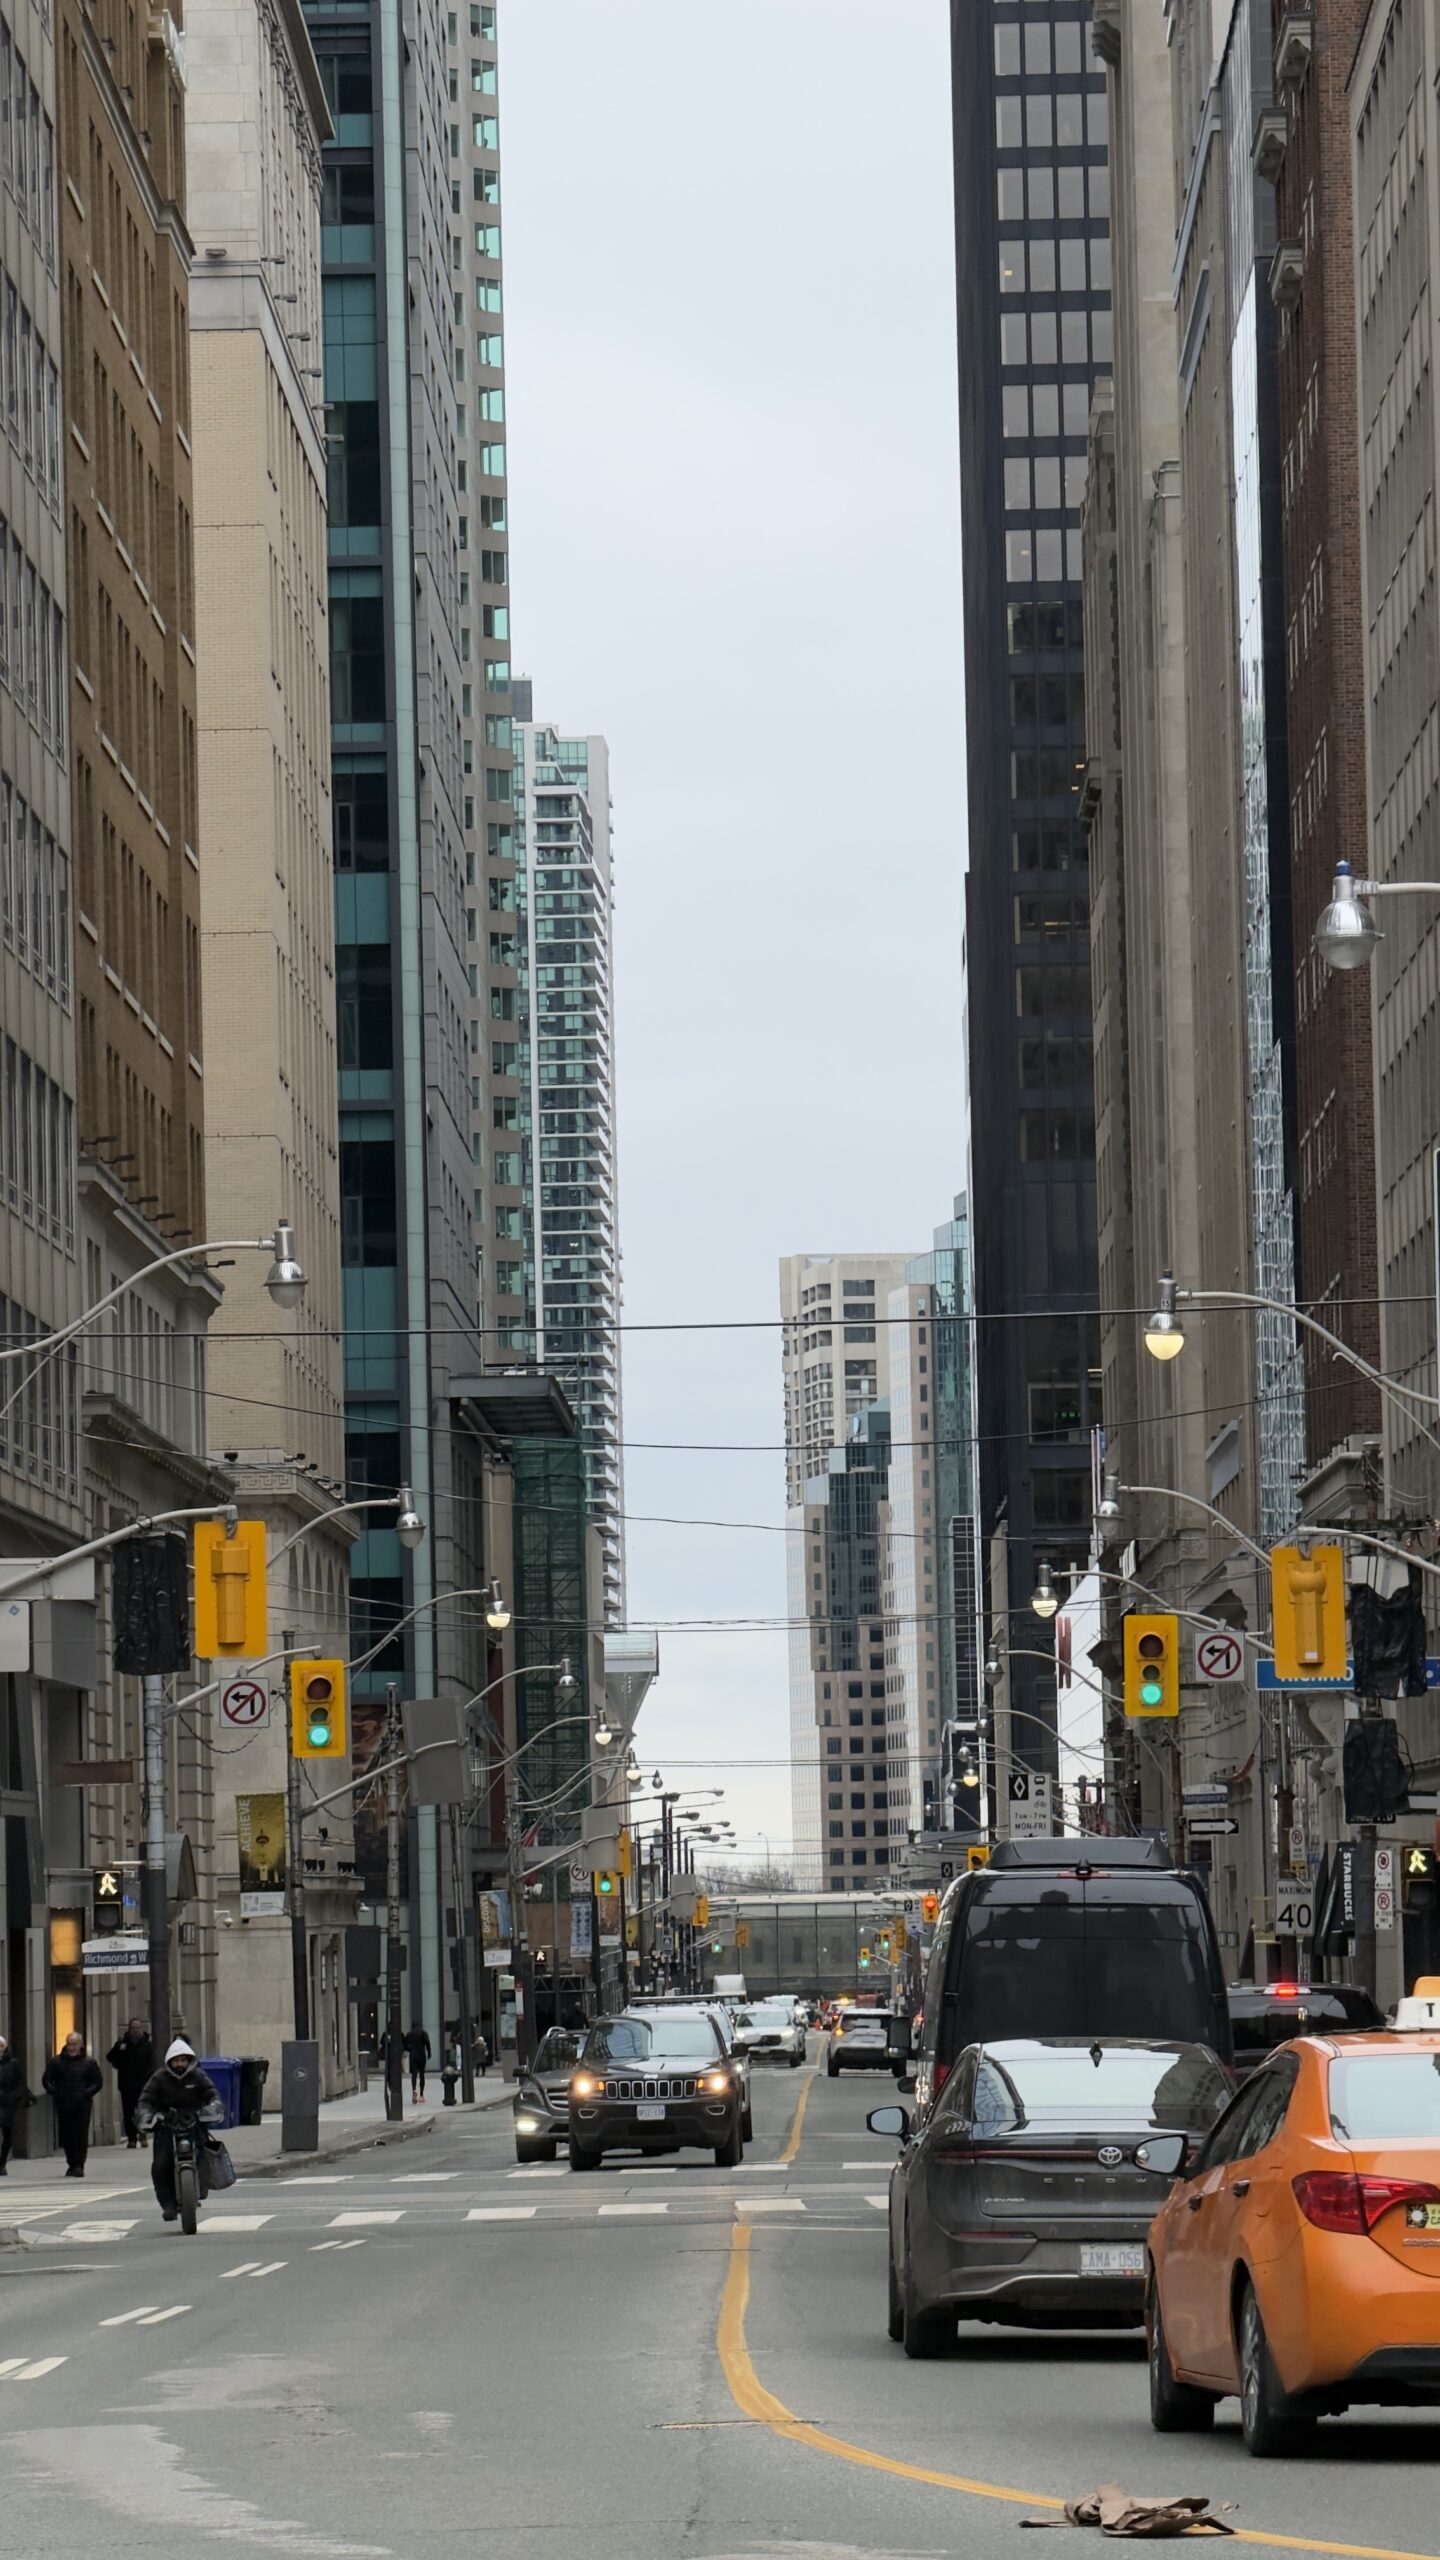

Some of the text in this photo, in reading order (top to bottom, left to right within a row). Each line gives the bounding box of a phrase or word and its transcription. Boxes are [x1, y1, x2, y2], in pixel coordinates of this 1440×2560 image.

[239, 1796, 252, 1852] ACHIEVE
[1278, 1886, 1312, 1894] MAXIMUM
[1343, 1852, 1354, 1920] STARBUCKS
[1278, 1904, 1311, 1928] 40
[84, 1953, 129, 1965] Richmond
[138, 1951, 148, 1962] W
